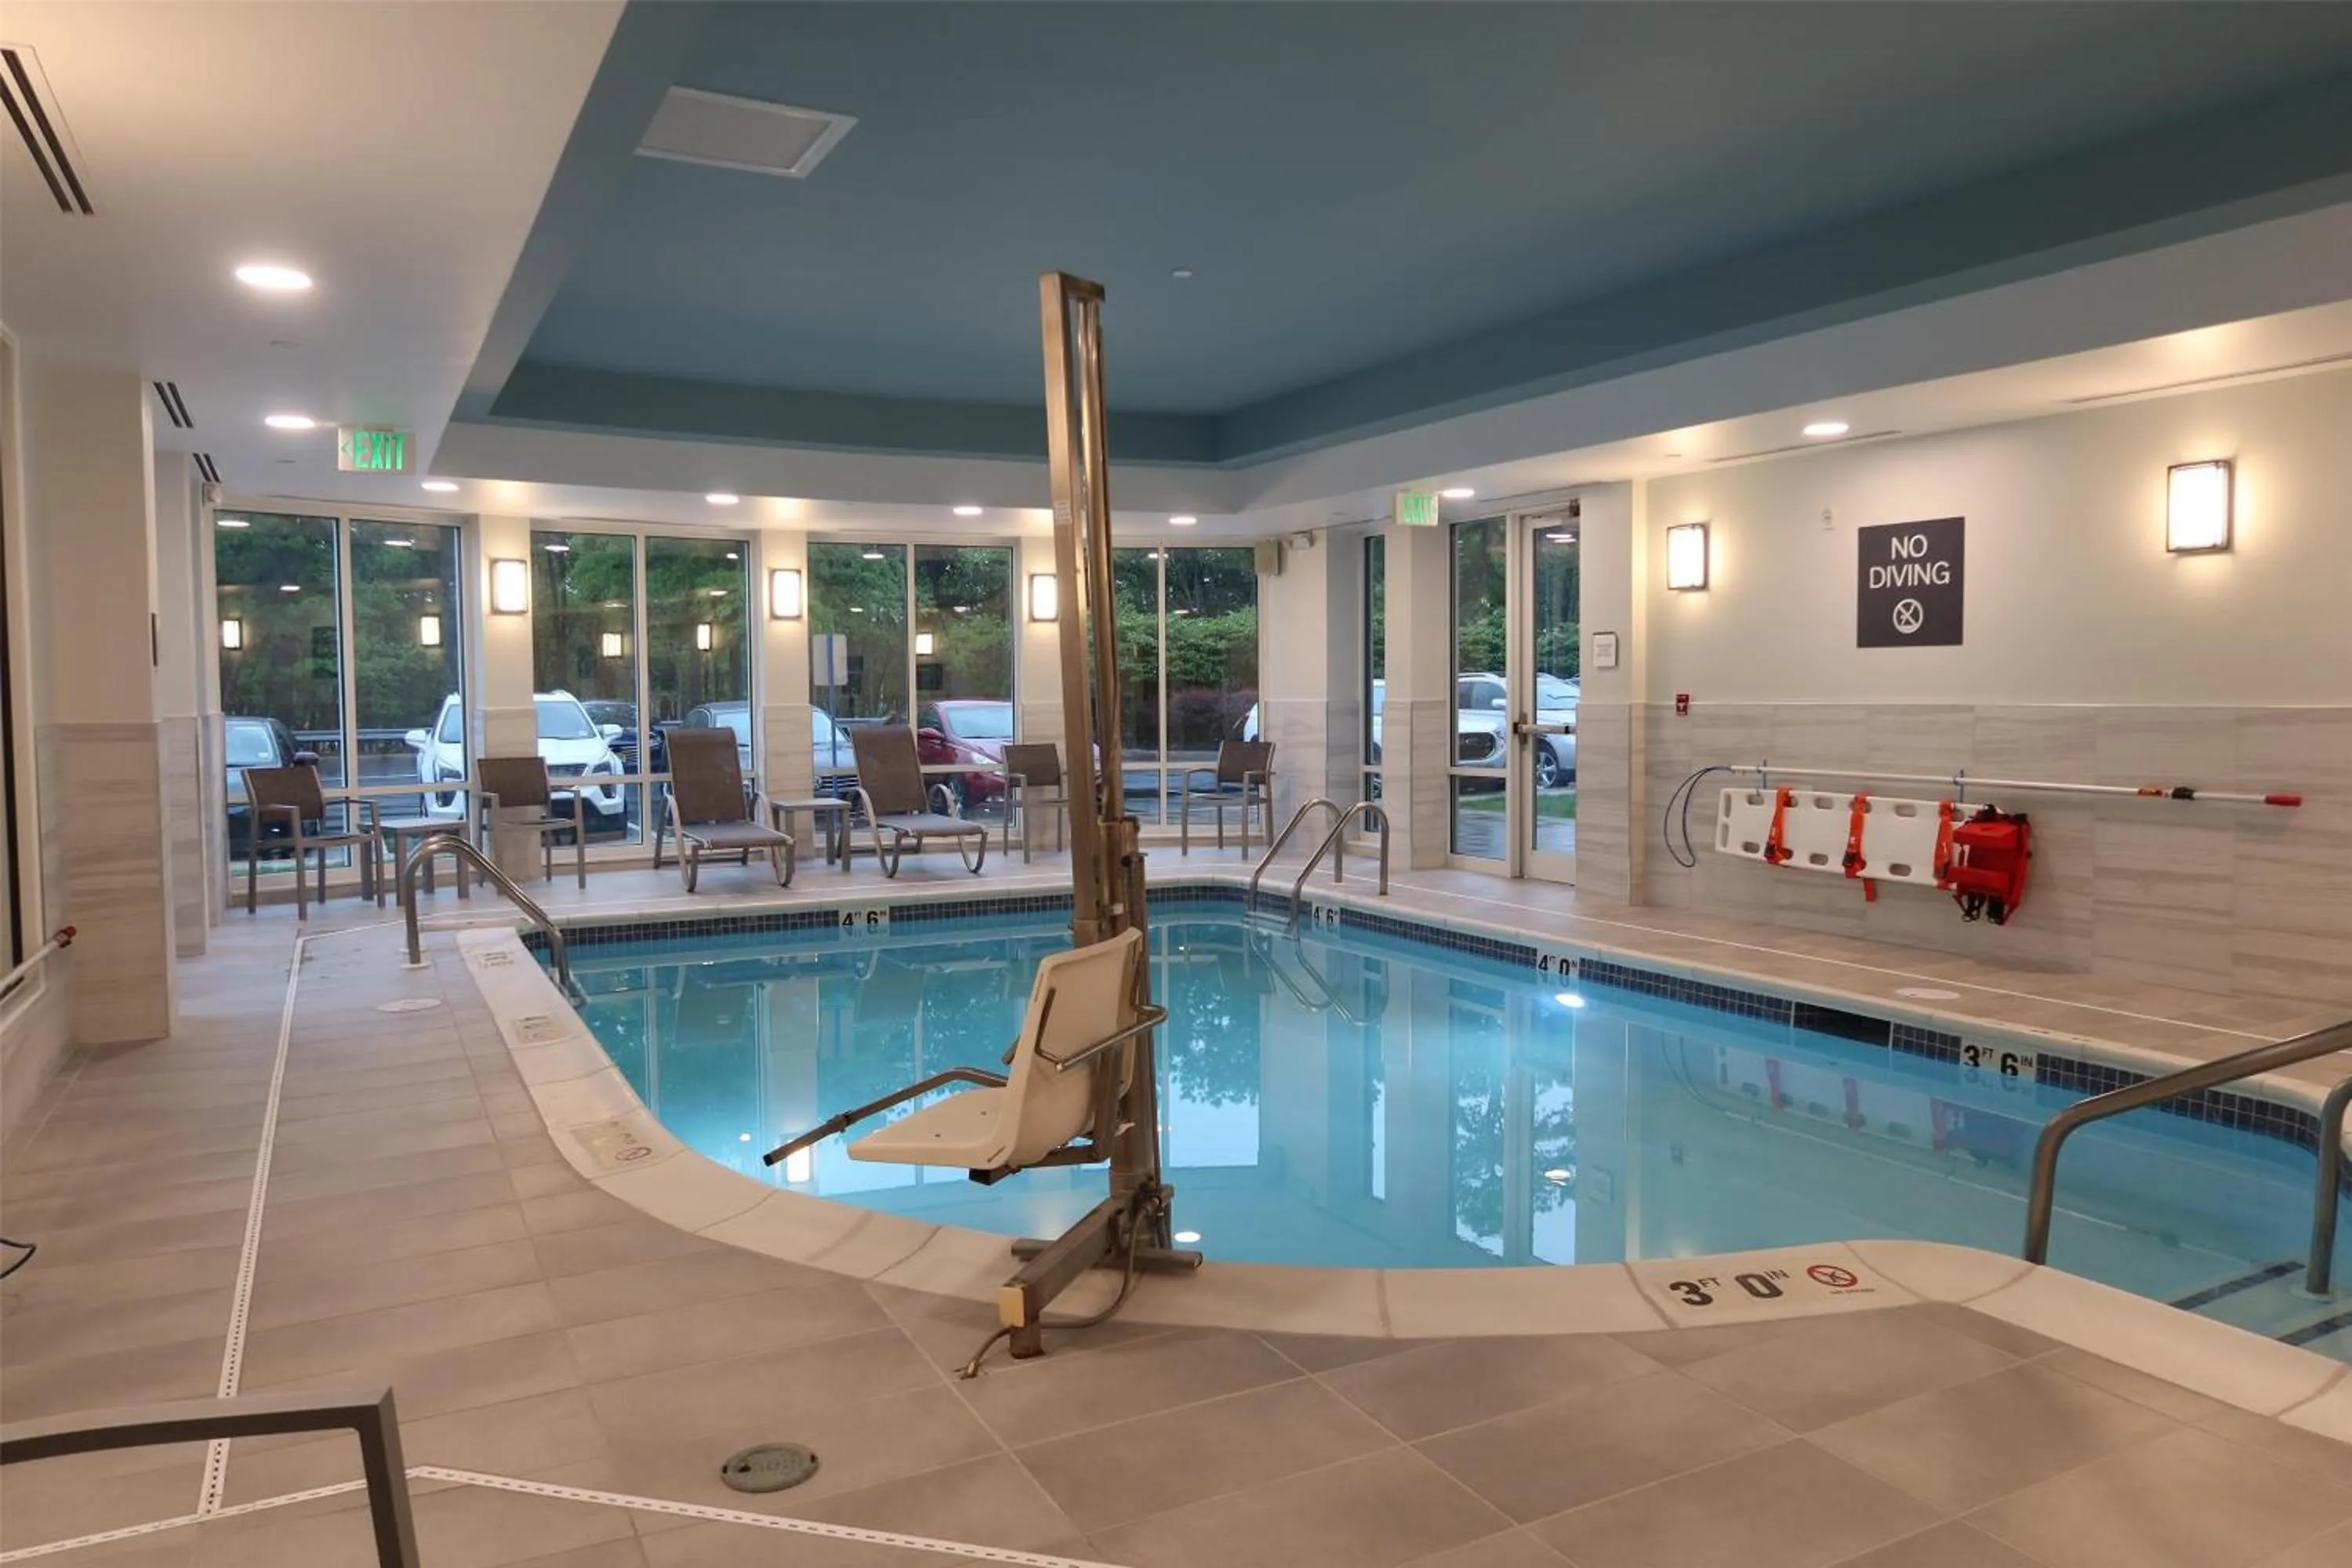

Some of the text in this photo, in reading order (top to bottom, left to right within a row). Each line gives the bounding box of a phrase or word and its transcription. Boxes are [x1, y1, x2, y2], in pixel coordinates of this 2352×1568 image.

[353, 431, 403, 470] EXIT
[1891, 534, 1928, 560] NO
[1869, 561, 1951, 589] DIVING
